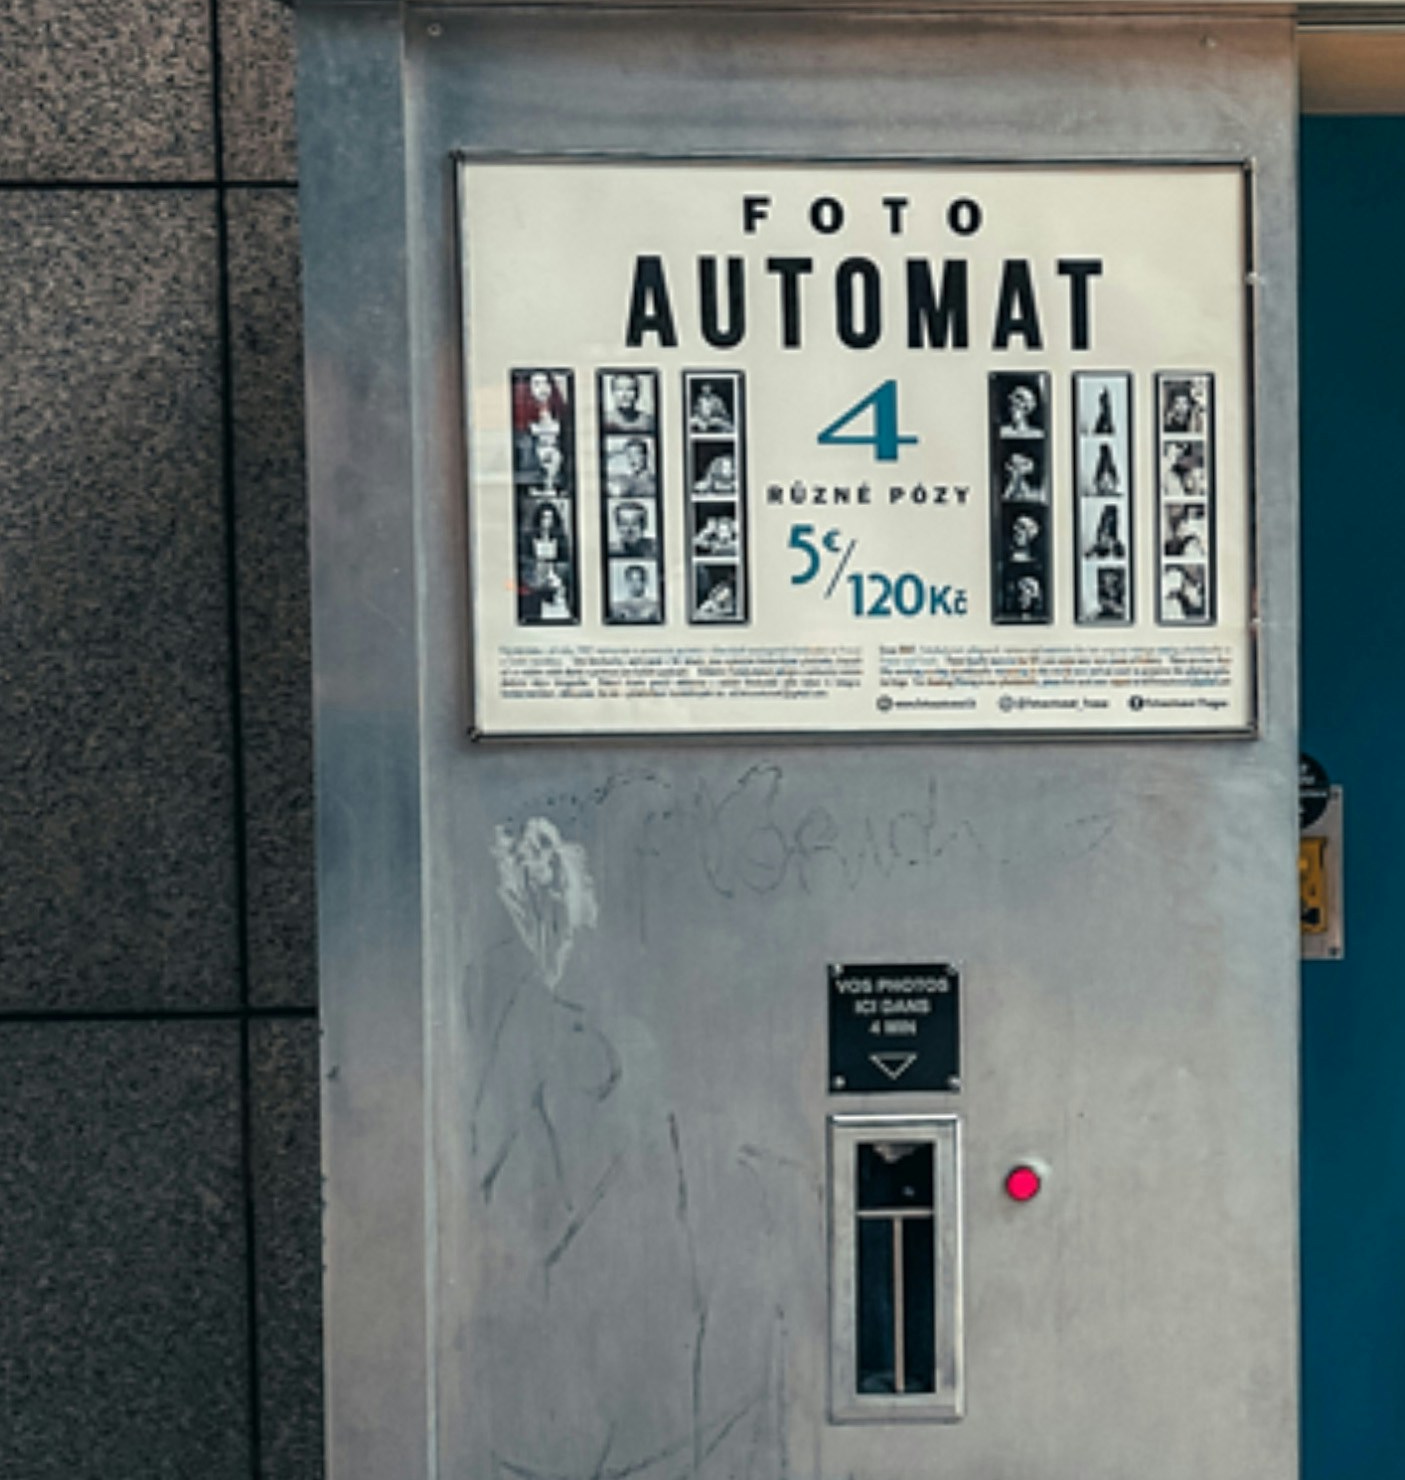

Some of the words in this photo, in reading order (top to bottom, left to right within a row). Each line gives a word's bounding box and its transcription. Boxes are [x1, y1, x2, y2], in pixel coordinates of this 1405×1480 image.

[742, 195, 983, 237] FOTO
[625, 255, 1103, 351] AUTOMAT
[816, 379, 919, 463] 4
[889, 483, 970, 505] PÓZY
[835, 978, 873, 994] VOS
[876, 978, 949, 994] PHOTOS
[854, 999, 877, 1014] ICI
[881, 998, 931, 1014] DANS
[868, 1019, 881, 1035] 4
[884, 1019, 917, 1035] MIN
